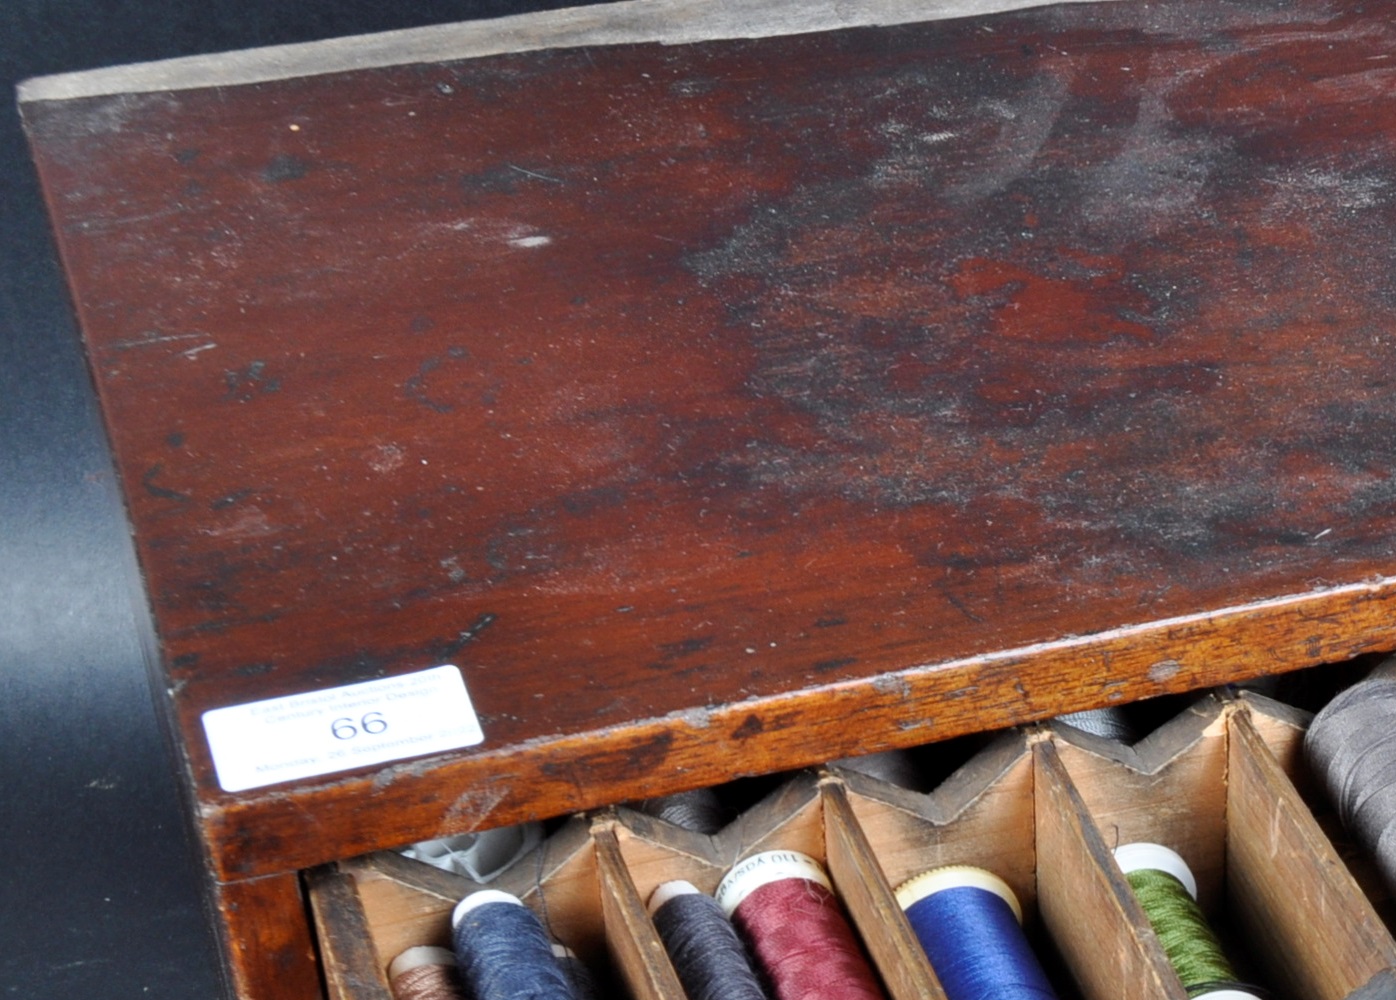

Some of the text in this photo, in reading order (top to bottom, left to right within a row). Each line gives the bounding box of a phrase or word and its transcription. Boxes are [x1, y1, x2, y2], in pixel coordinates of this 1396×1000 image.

[249, 672, 441, 716] East Bristol Auctions 20th
[264, 685, 438, 725] Century Interior Design
[330, 711, 389, 741] 66
[351, 733, 434, 758] September
